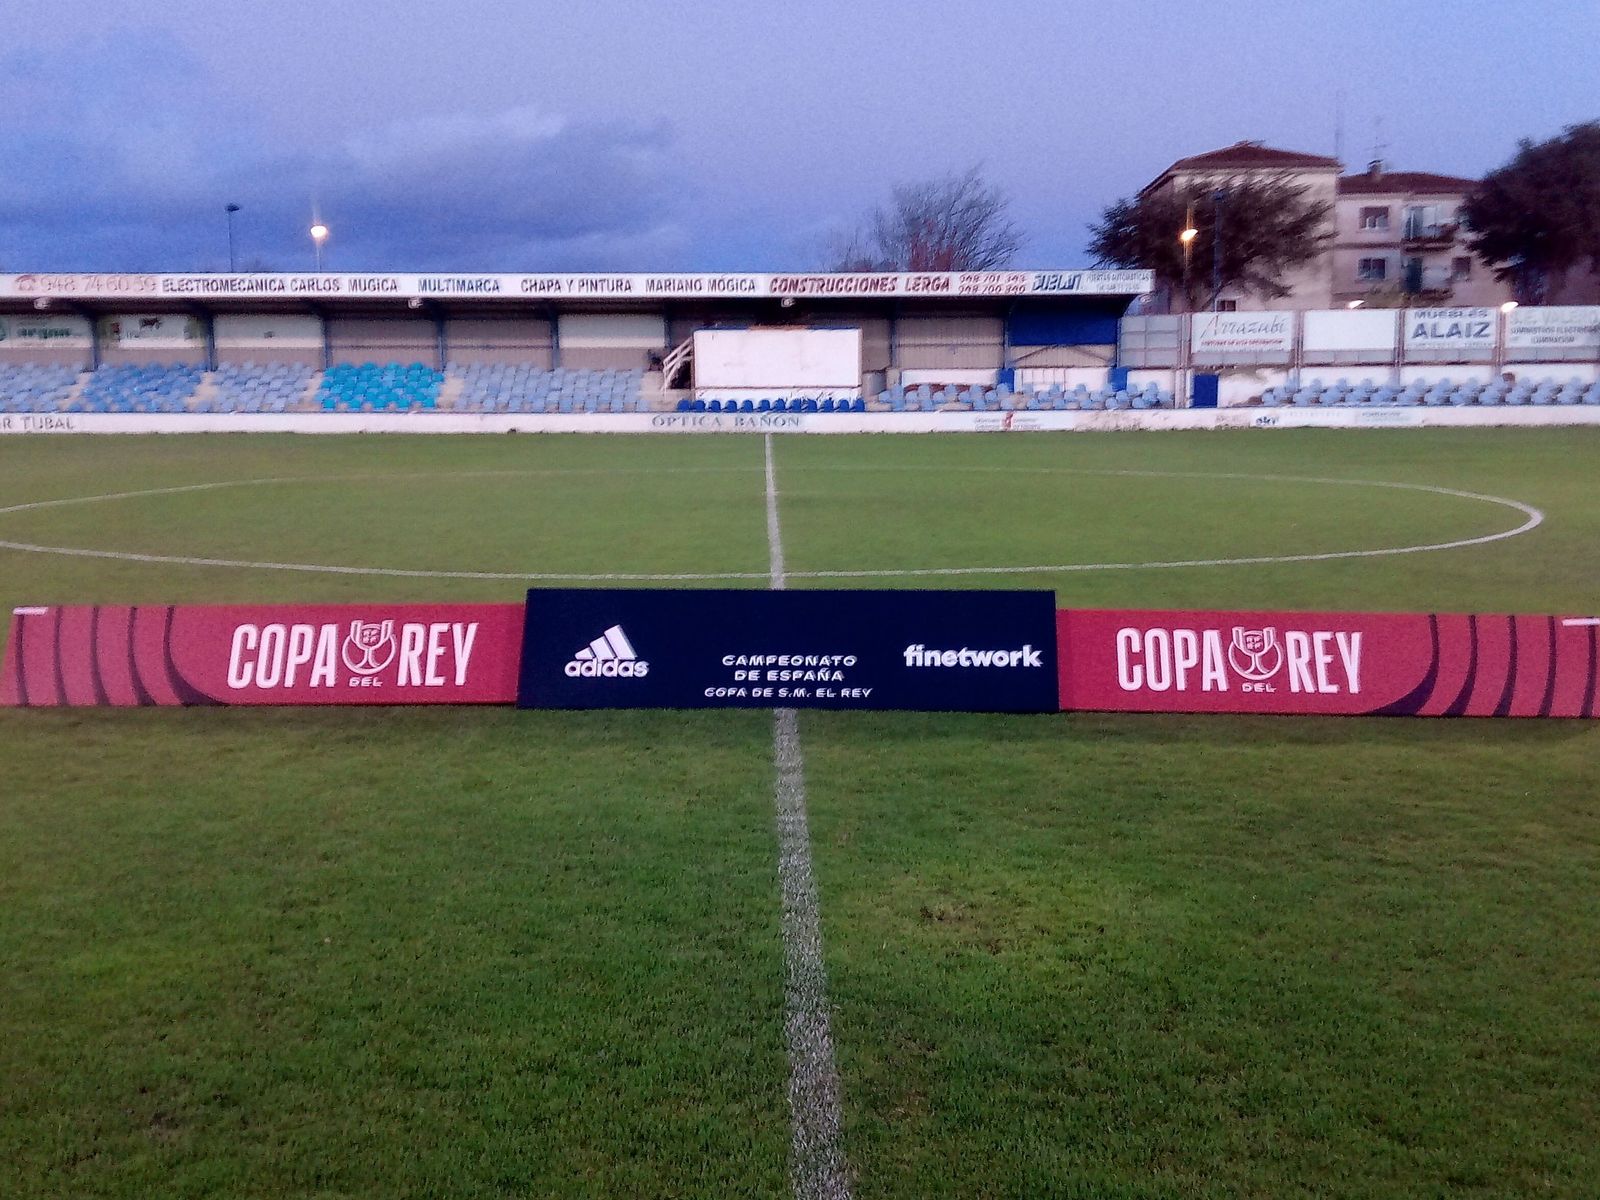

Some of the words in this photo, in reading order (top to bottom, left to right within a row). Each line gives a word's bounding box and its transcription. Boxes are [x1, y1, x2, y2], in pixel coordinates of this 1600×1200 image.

[290, 278, 340, 292] CARLOS
[418, 278, 500, 293] MULTIMARCA
[521, 278, 562, 293] CHAPA
[565, 278, 574, 293] Y
[578, 278, 632, 293] PINTURA
[645, 278, 703, 293] MARIANO
[769, 277, 898, 293] CONSTRUCCIONES
[905, 276, 950, 292] LERGA
[1411, 322, 1490, 339] ALAIZ
[19, 416, 74, 430] TUBAL
[226, 623, 337, 689] COPA
[349, 676, 383, 687] DEL
[396, 621, 480, 687] REY
[722, 655, 857, 666] CAMPEONATO
[903, 643, 1044, 668] finetwork
[1115, 627, 1230, 692] COPA
[1242, 682, 1277, 693] DEL
[1286, 630, 1362, 694] REY
[564, 657, 649, 677] adidas
[734, 670, 761, 681] DE
[767, 668, 845, 682] ESPAÑA
[704, 687, 748, 698] COPA
[752, 687, 775, 698] DE
[778, 687, 812, 698] S.M.
[816, 687, 837, 698] EL
[841, 687, 873, 698] REY
